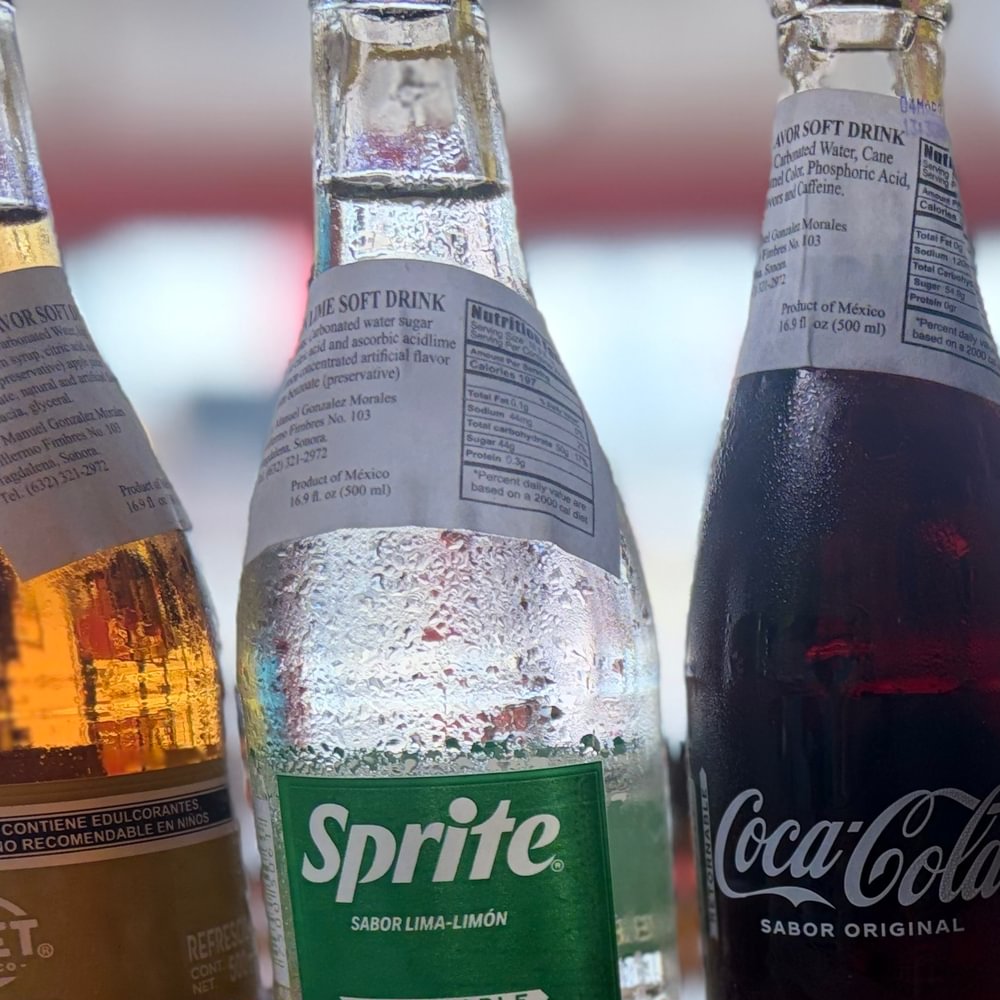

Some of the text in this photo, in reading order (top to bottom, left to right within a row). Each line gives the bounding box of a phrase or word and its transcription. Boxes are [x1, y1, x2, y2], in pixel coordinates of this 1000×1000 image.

[802, 119, 844, 138] SOFT
[848, 121, 906, 146] DRINK
[820, 140, 894, 165] Water, Cane
[807, 160, 910, 189] Phosphoric Acid,
[802, 218, 848, 232] Morales
[802, 234, 822, 247] 103
[338, 289, 446, 314] SOFT DRINK
[821, 300, 886, 319] of México
[364, 316, 433, 331] water sugar
[813, 318, 886, 337] oz (500 ml)
[329, 333, 399, 352] and ascorbic
[414, 350, 451, 366] flavor
[469, 360, 516, 379] Calories
[350, 391, 398, 406] Morales
[351, 409, 371, 422] 103
[291, 468, 390, 492] Product of México
[471, 482, 505, 497] based
[339, 485, 367, 499] (500
[2, 815, 87, 836] CONTIENE
[22, 825, 153, 851] RECOMENDABLE
[157, 820, 175, 834] EN
[302, 797, 561, 903] Sprite
[351, 908, 509, 932] SABOR LIMA-LIMÓN
[760, 918, 966, 938] SABOR ORIGINAL
